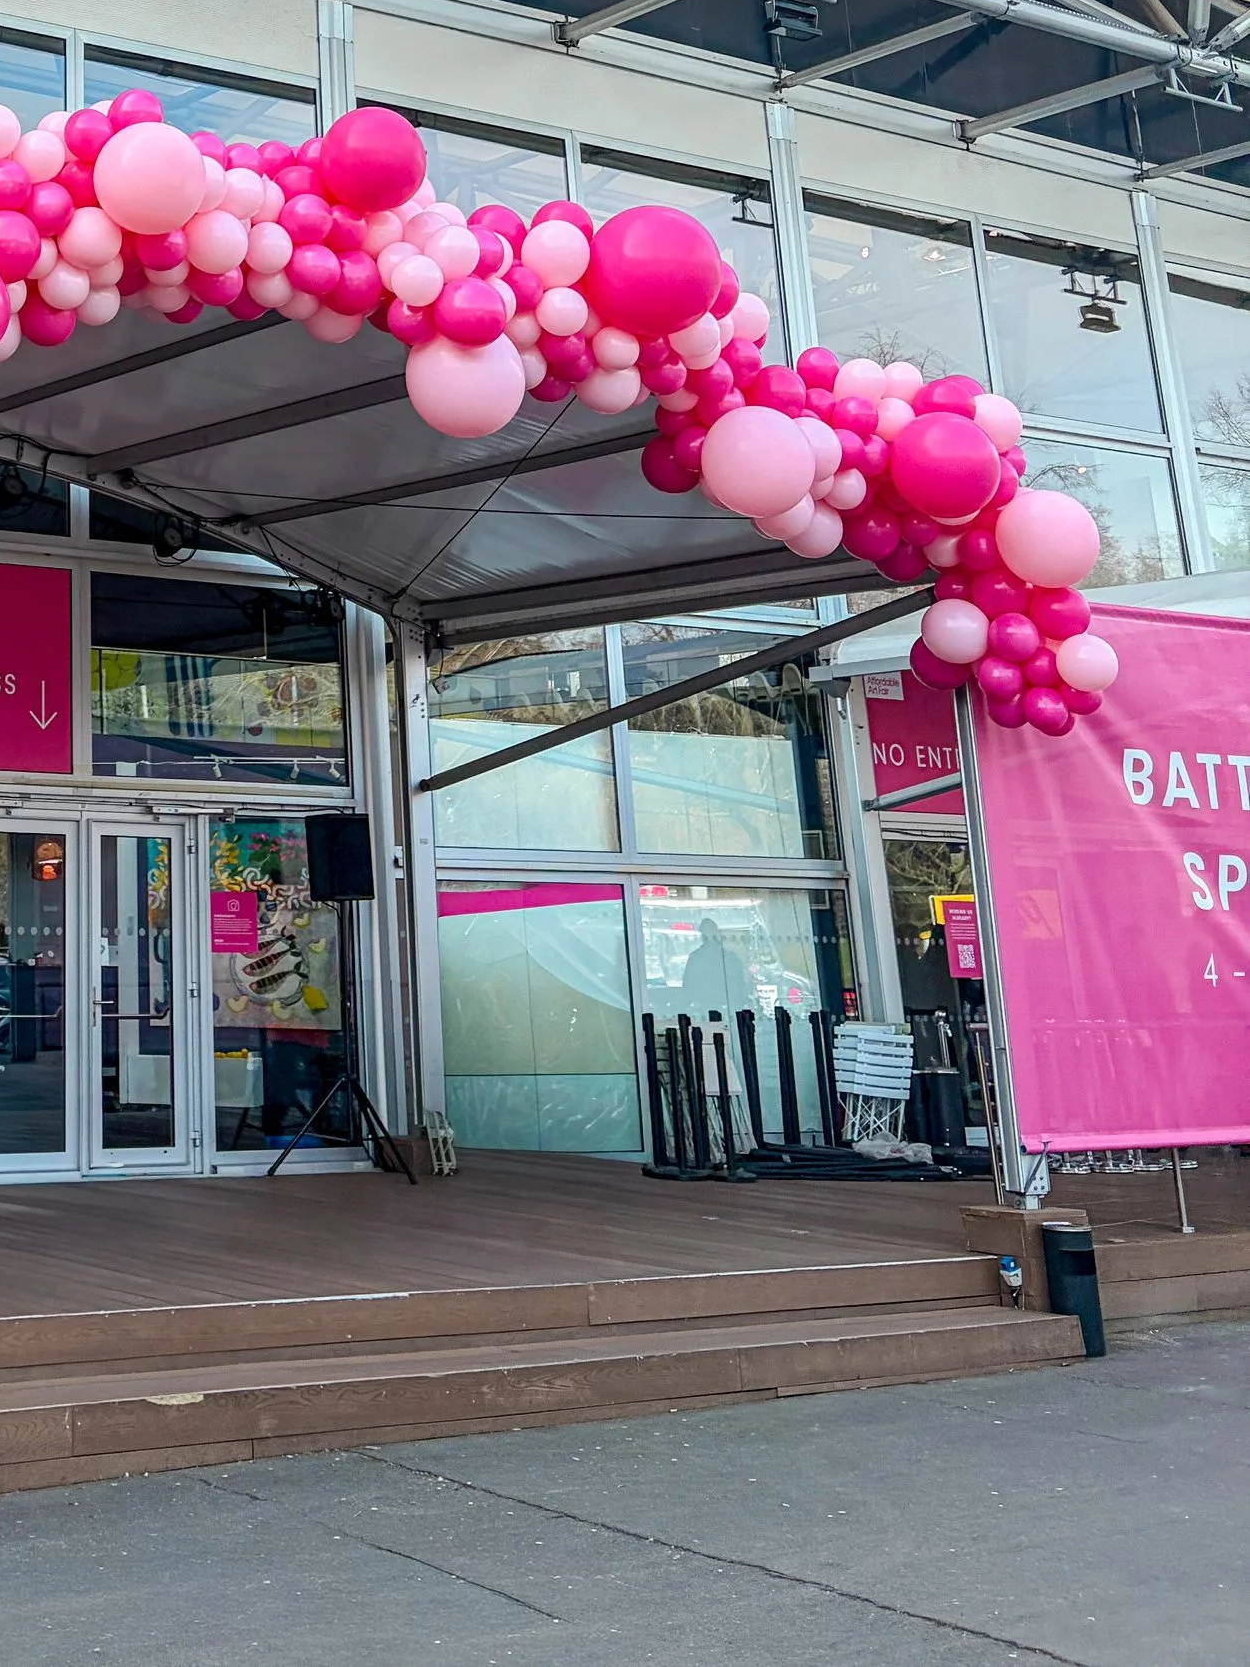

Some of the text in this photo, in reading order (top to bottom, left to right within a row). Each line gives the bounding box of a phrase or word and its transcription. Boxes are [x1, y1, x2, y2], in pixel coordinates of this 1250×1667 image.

[866, 675, 900, 688] Affordable
[867, 685, 879, 695] Art
[872, 742, 905, 767] NO
[1122, 748, 1250, 811] BATT
[1182, 851, 1248, 911] SP
[1203, 953, 1219, 987] 4
